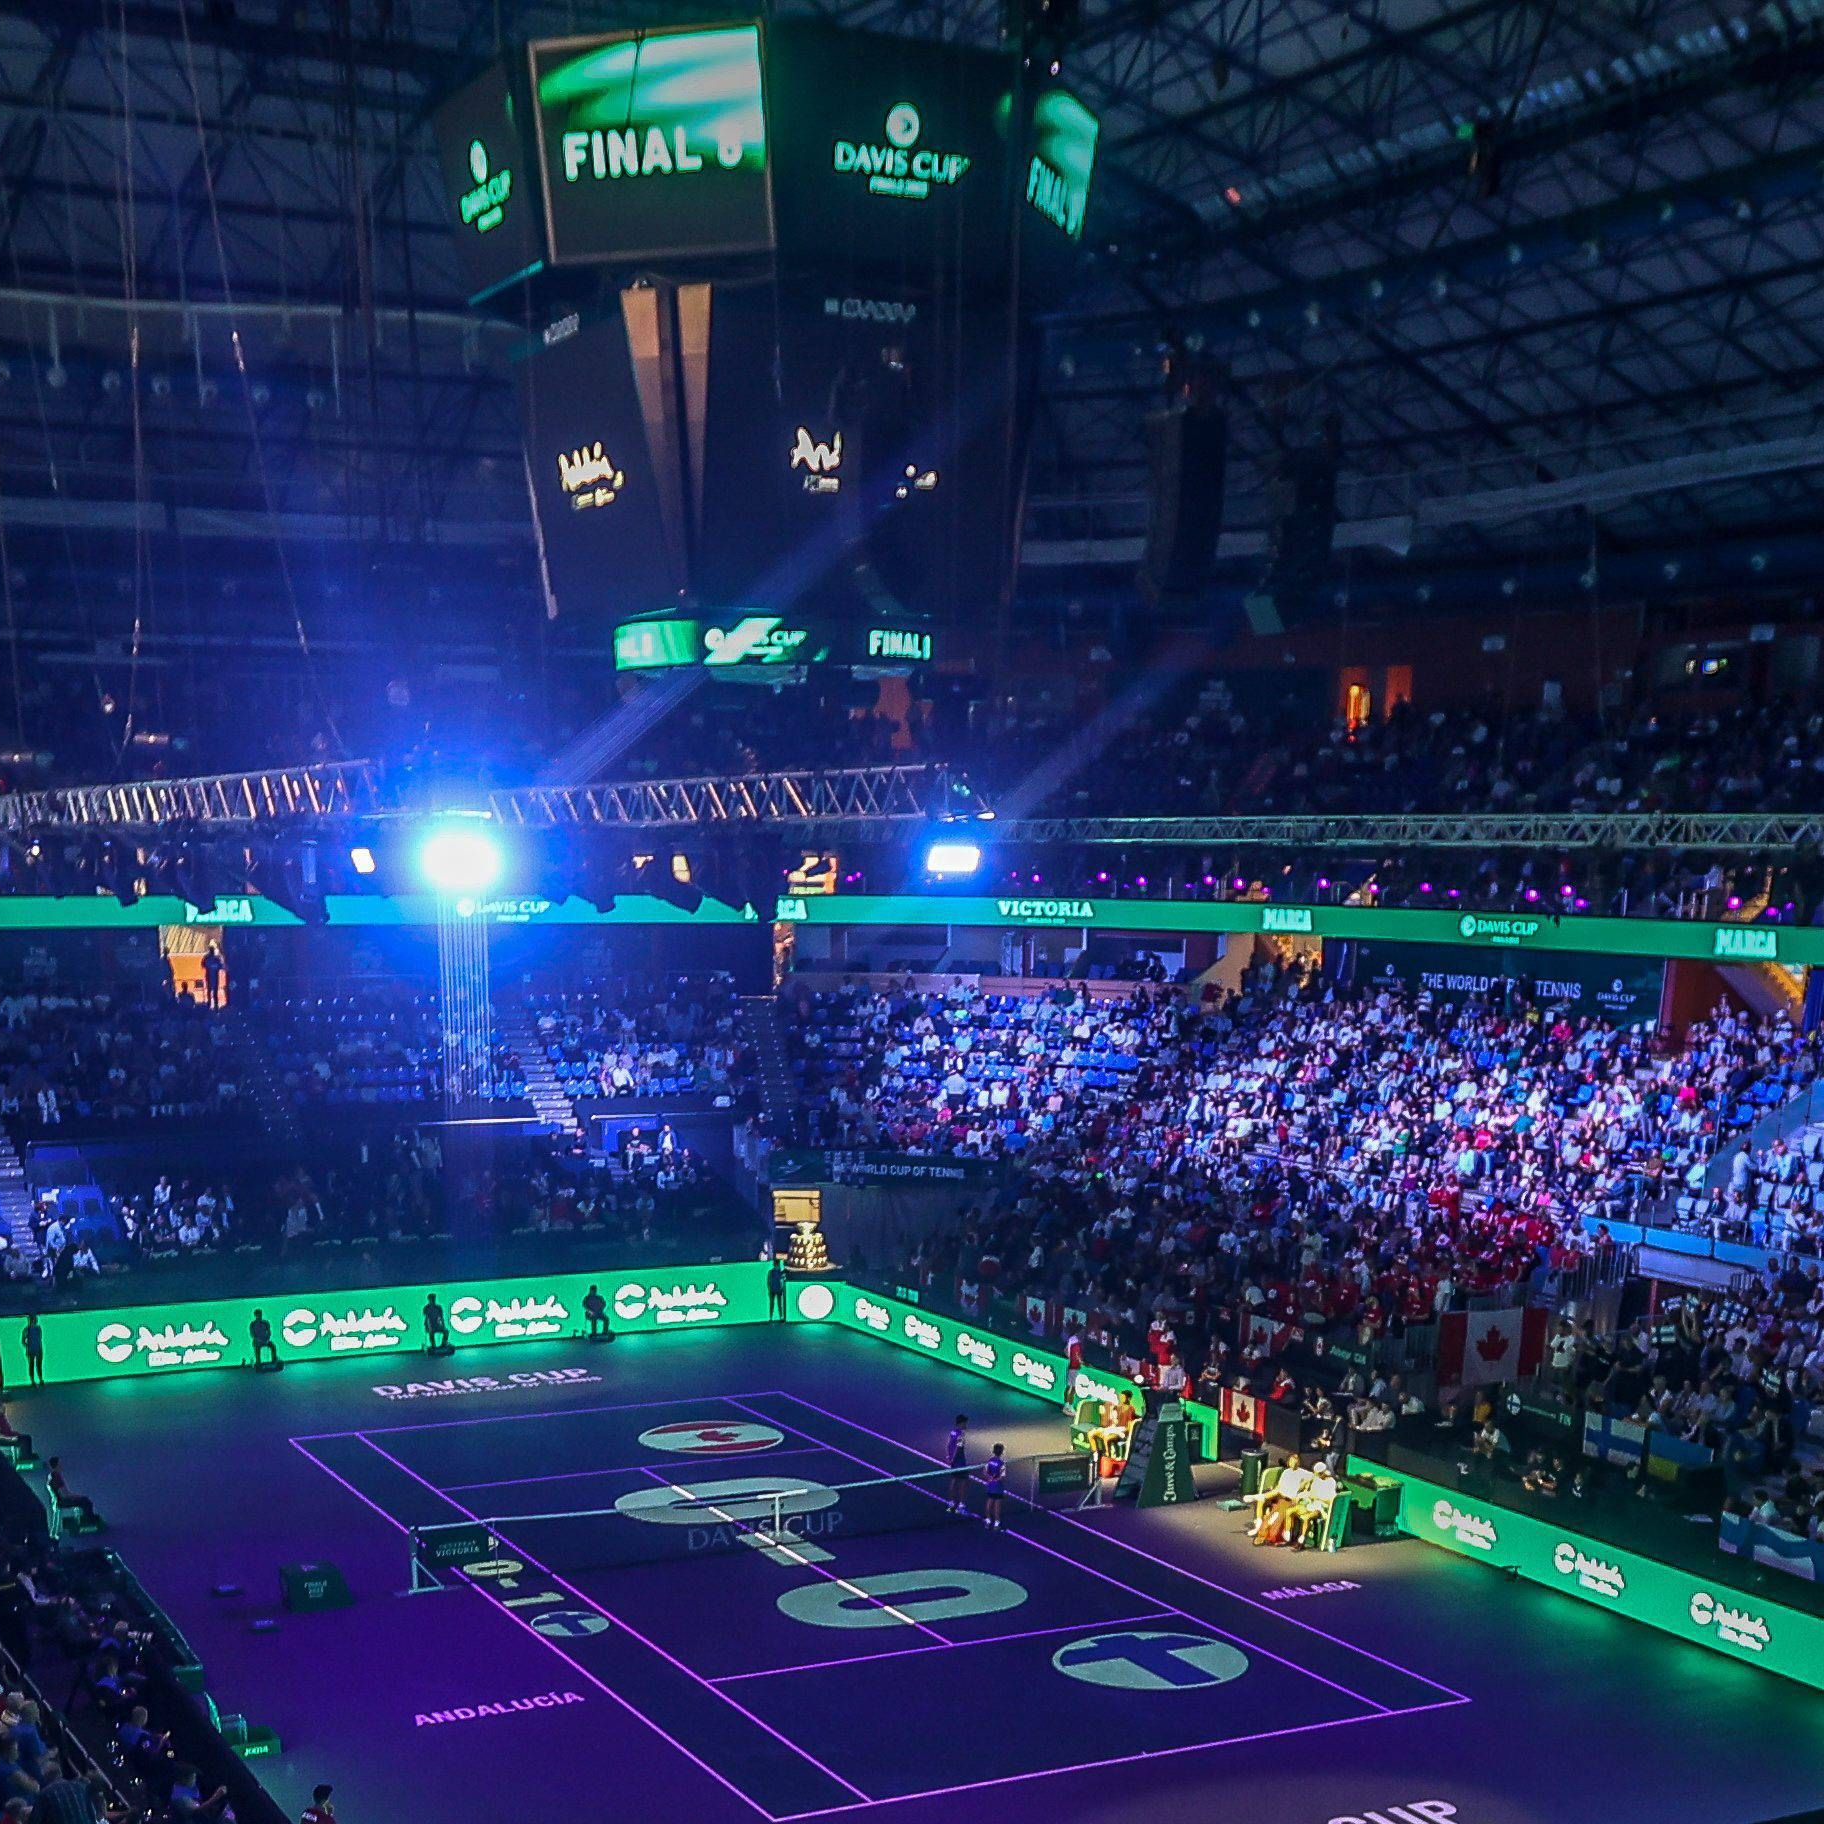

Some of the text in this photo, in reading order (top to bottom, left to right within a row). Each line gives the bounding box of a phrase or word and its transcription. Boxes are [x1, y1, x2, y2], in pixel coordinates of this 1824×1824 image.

[562, 125, 704, 182] FINAL
[833, 140, 909, 178] DAVIS
[997, 900, 1094, 917] VICTORIA
[1262, 907, 1313, 931] MARCA
[1476, 920, 1539, 938] DAVIS CUP
[1713, 928, 1777, 958] MARCA
[1535, 980, 1582, 1000] TENNIS
[371, 1368, 588, 1398] DAVIS CUP
[784, 1511, 844, 1536] CUP
[413, 1690, 586, 1727] ANDALUCÍA
